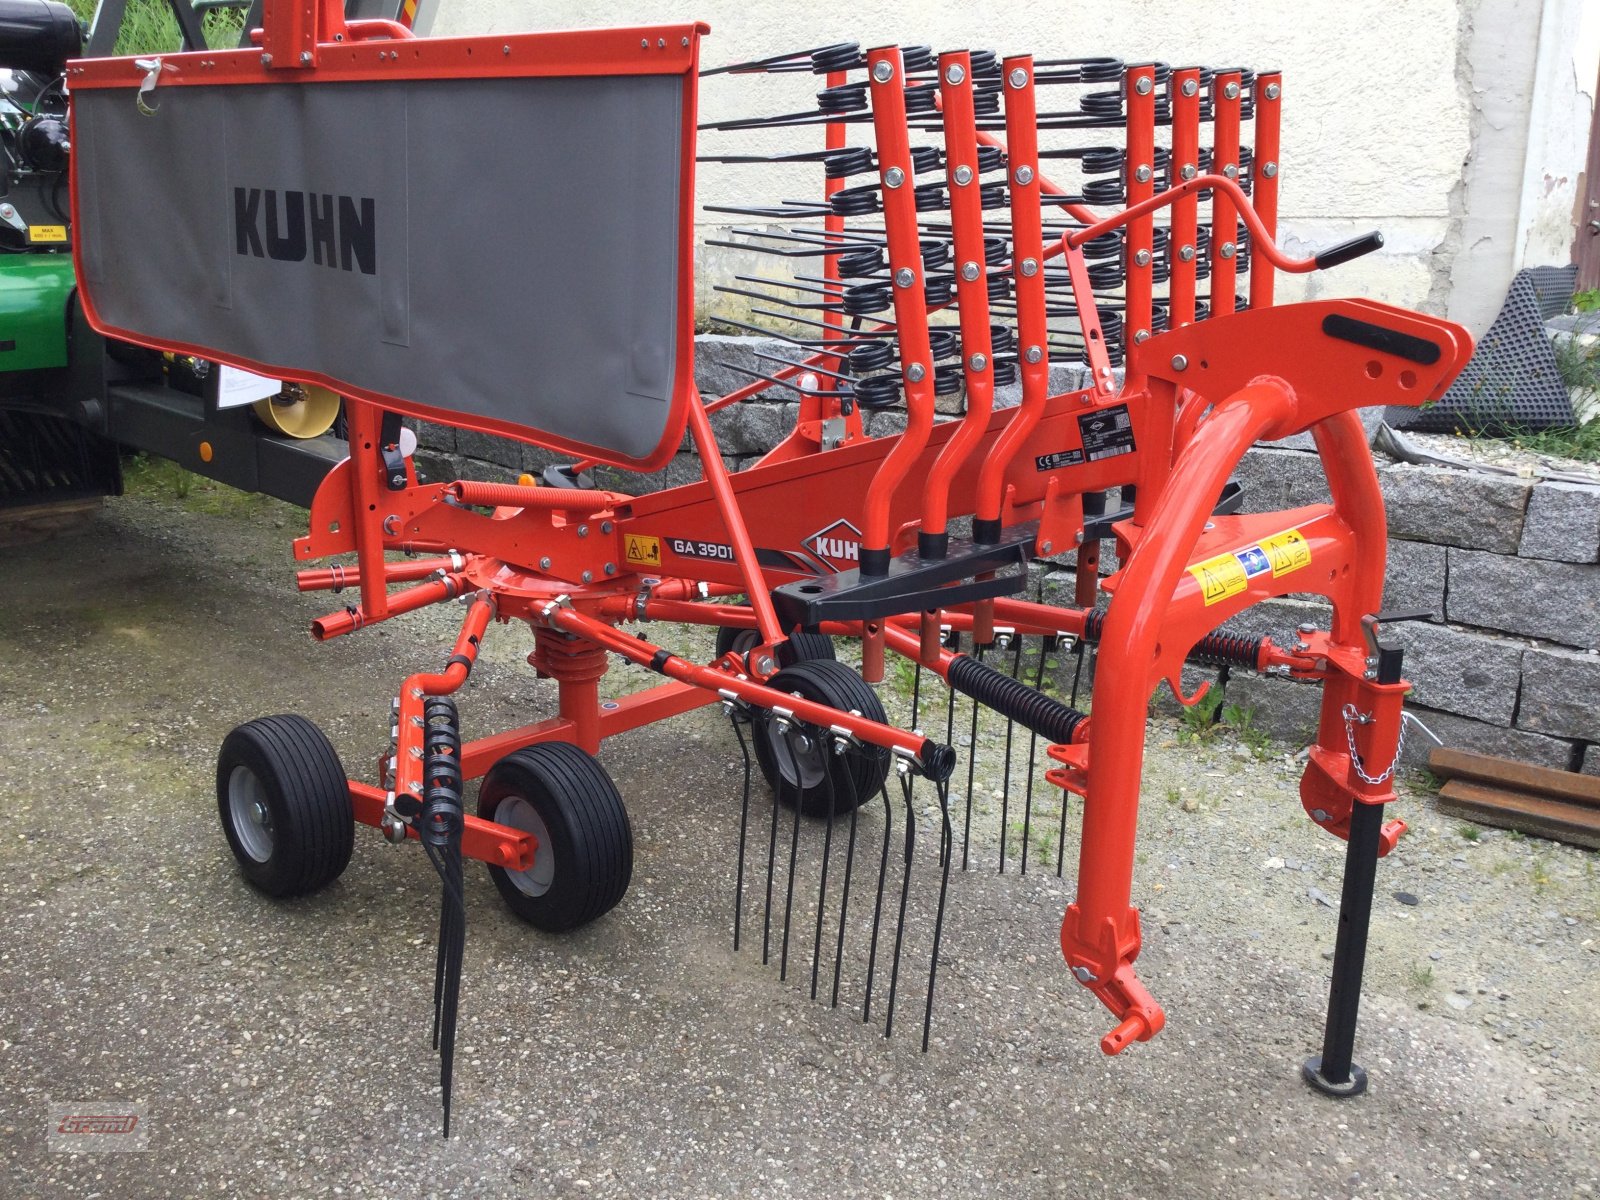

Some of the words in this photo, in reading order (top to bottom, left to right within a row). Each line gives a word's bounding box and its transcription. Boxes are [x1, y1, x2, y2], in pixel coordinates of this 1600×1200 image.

[234, 187, 376, 275] KUHN
[674, 540, 695, 554] GA
[698, 543, 733, 559] 3901
[816, 536, 863, 561] KUH
